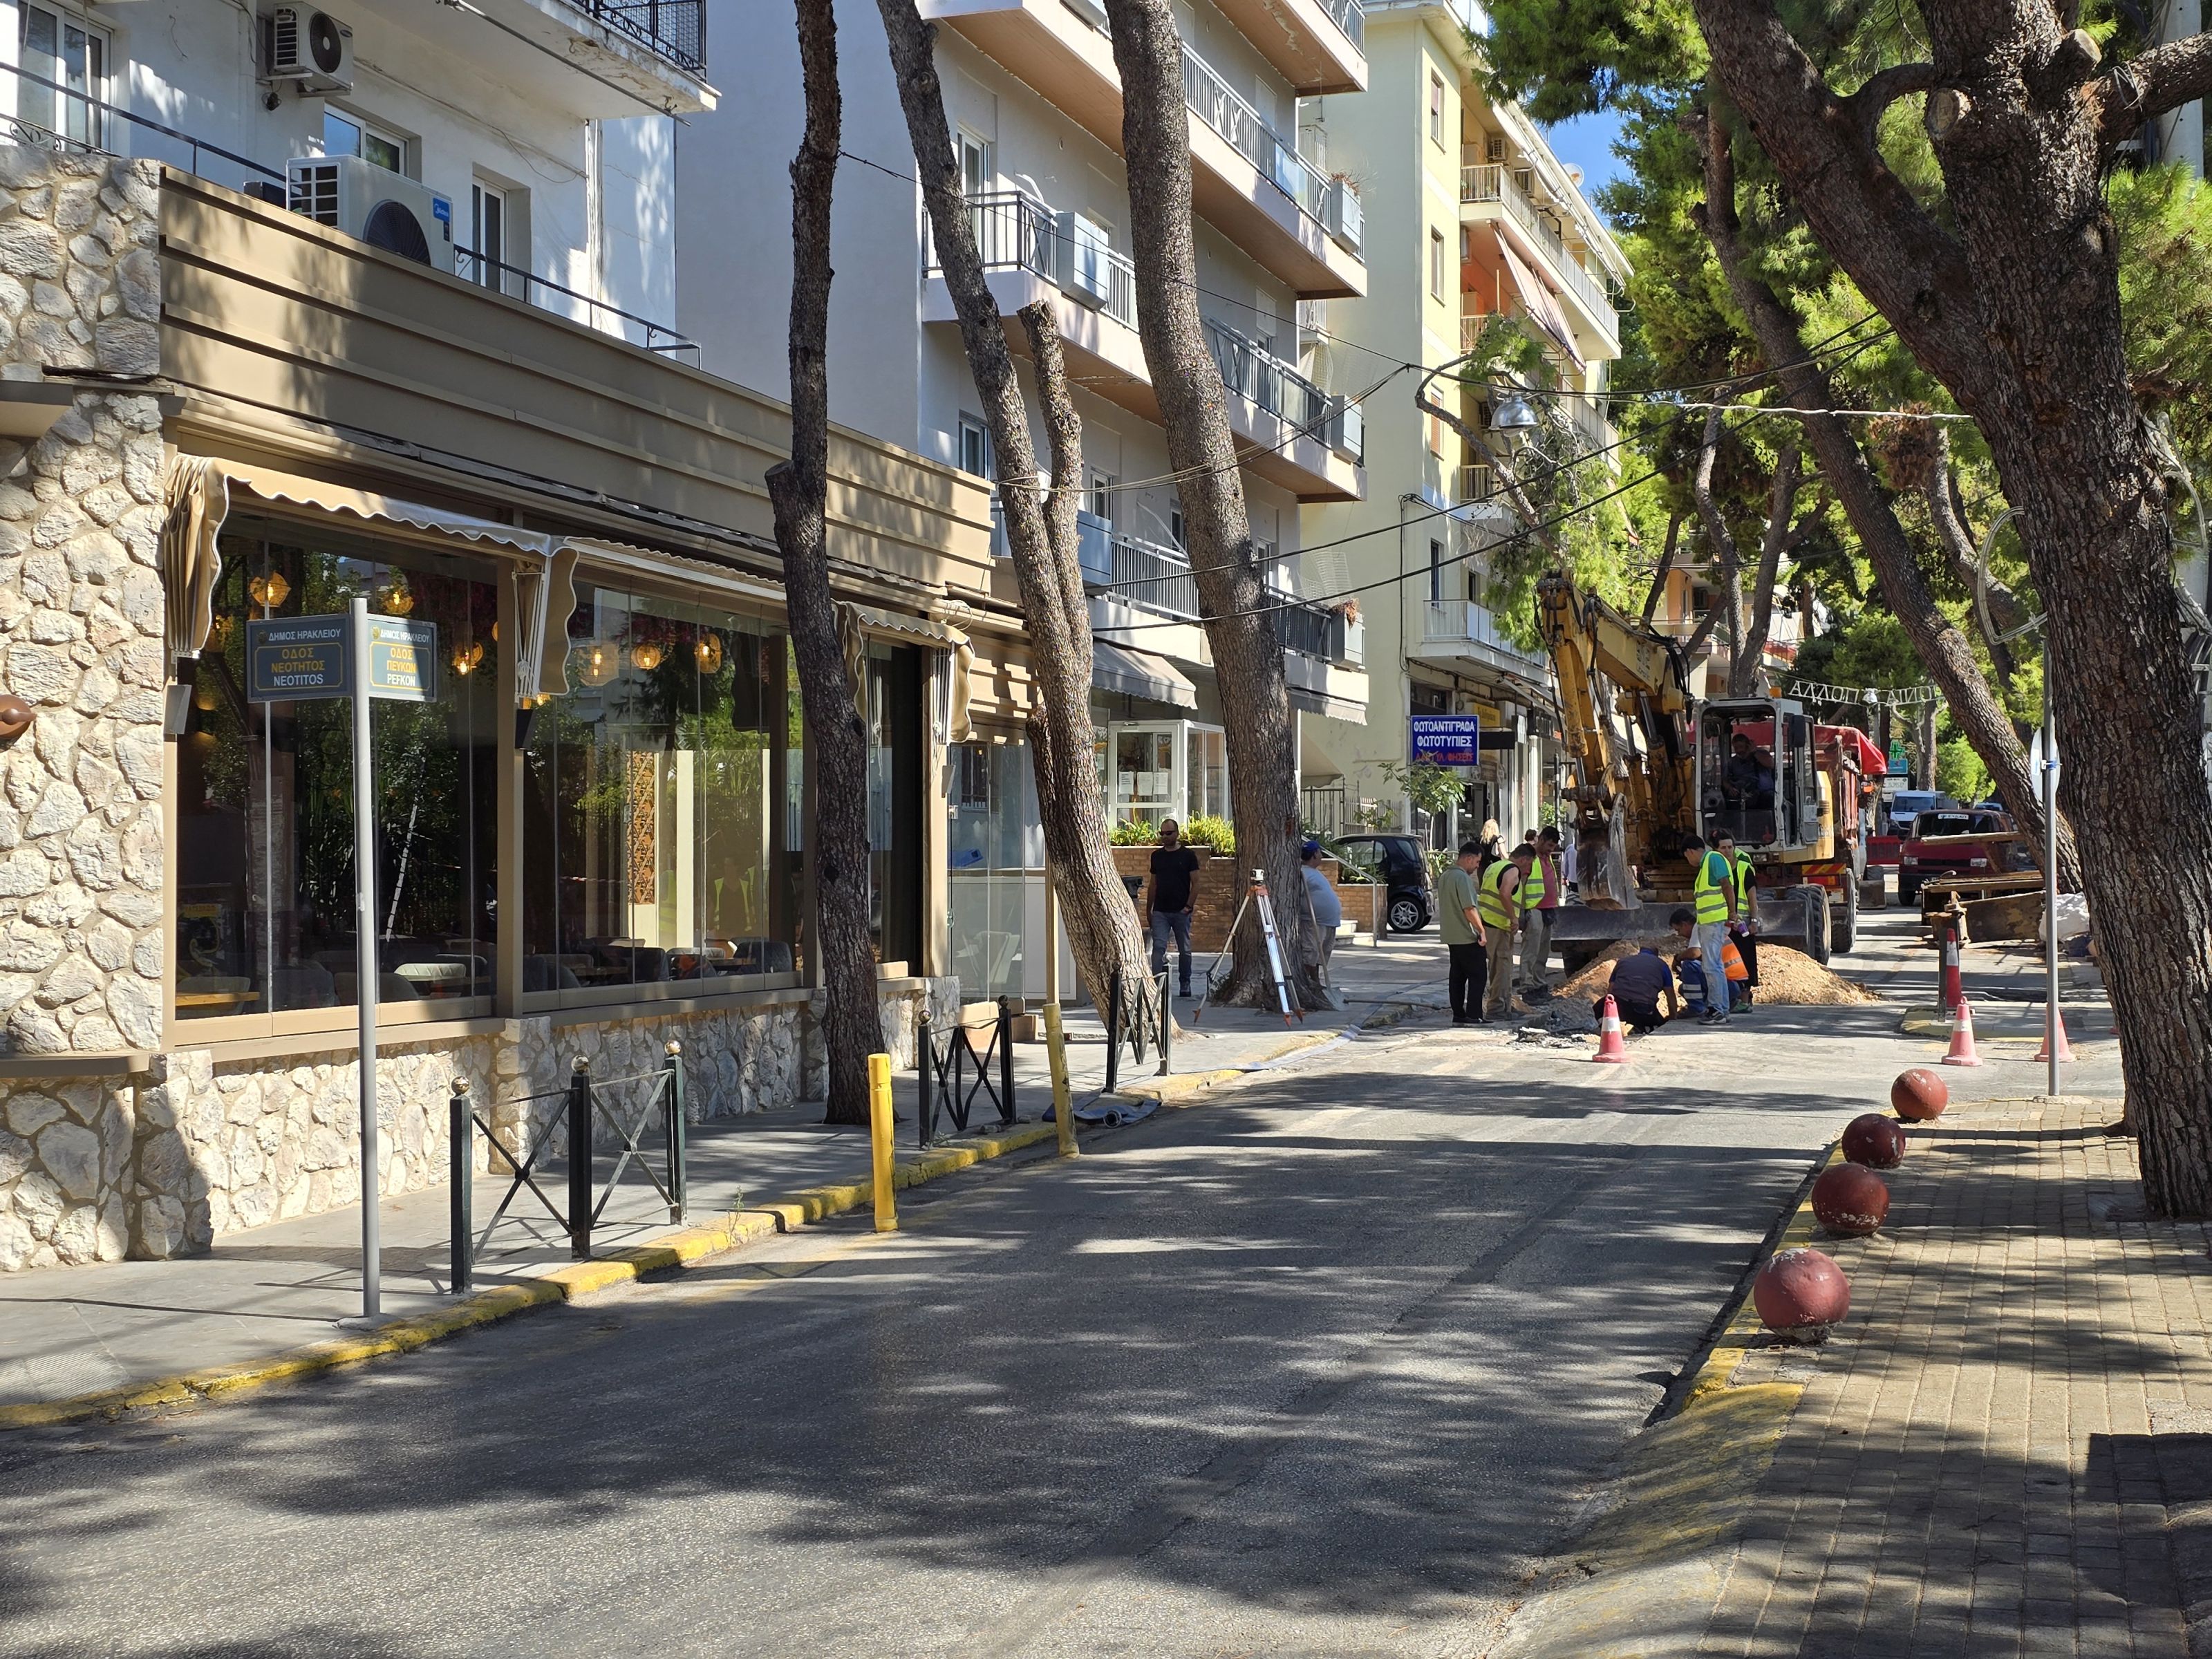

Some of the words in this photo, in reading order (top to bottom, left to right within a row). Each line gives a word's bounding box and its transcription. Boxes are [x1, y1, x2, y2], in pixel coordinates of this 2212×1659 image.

[268, 630, 296, 641] ΔΗΜΟΣ
[297, 628, 341, 639] ΗΡΑΚΛΕΙΟΥ
[380, 629, 400, 639] ΔΗΜΟΣ
[400, 631, 430, 643] ΗΡΑΚΛΕΙΟΥ
[282, 648, 314, 659] ΟΔΟΣ
[390, 648, 413, 660] ΟΔΟΣ
[271, 660, 325, 673] ΝΕΟΤΗΤΟΣ
[386, 661, 417, 673] ΠΕΥΚΩΝ
[273, 673, 324, 686] NEOTITOS
[387, 673, 415, 686] PEFKON
[1414, 721, 1475, 732] ΦΩΤΟΑΝΤΙΓΡΑΦΑ
[1417, 735, 1472, 747] ΦΩΤΟΤΥΠΙΕΣ
